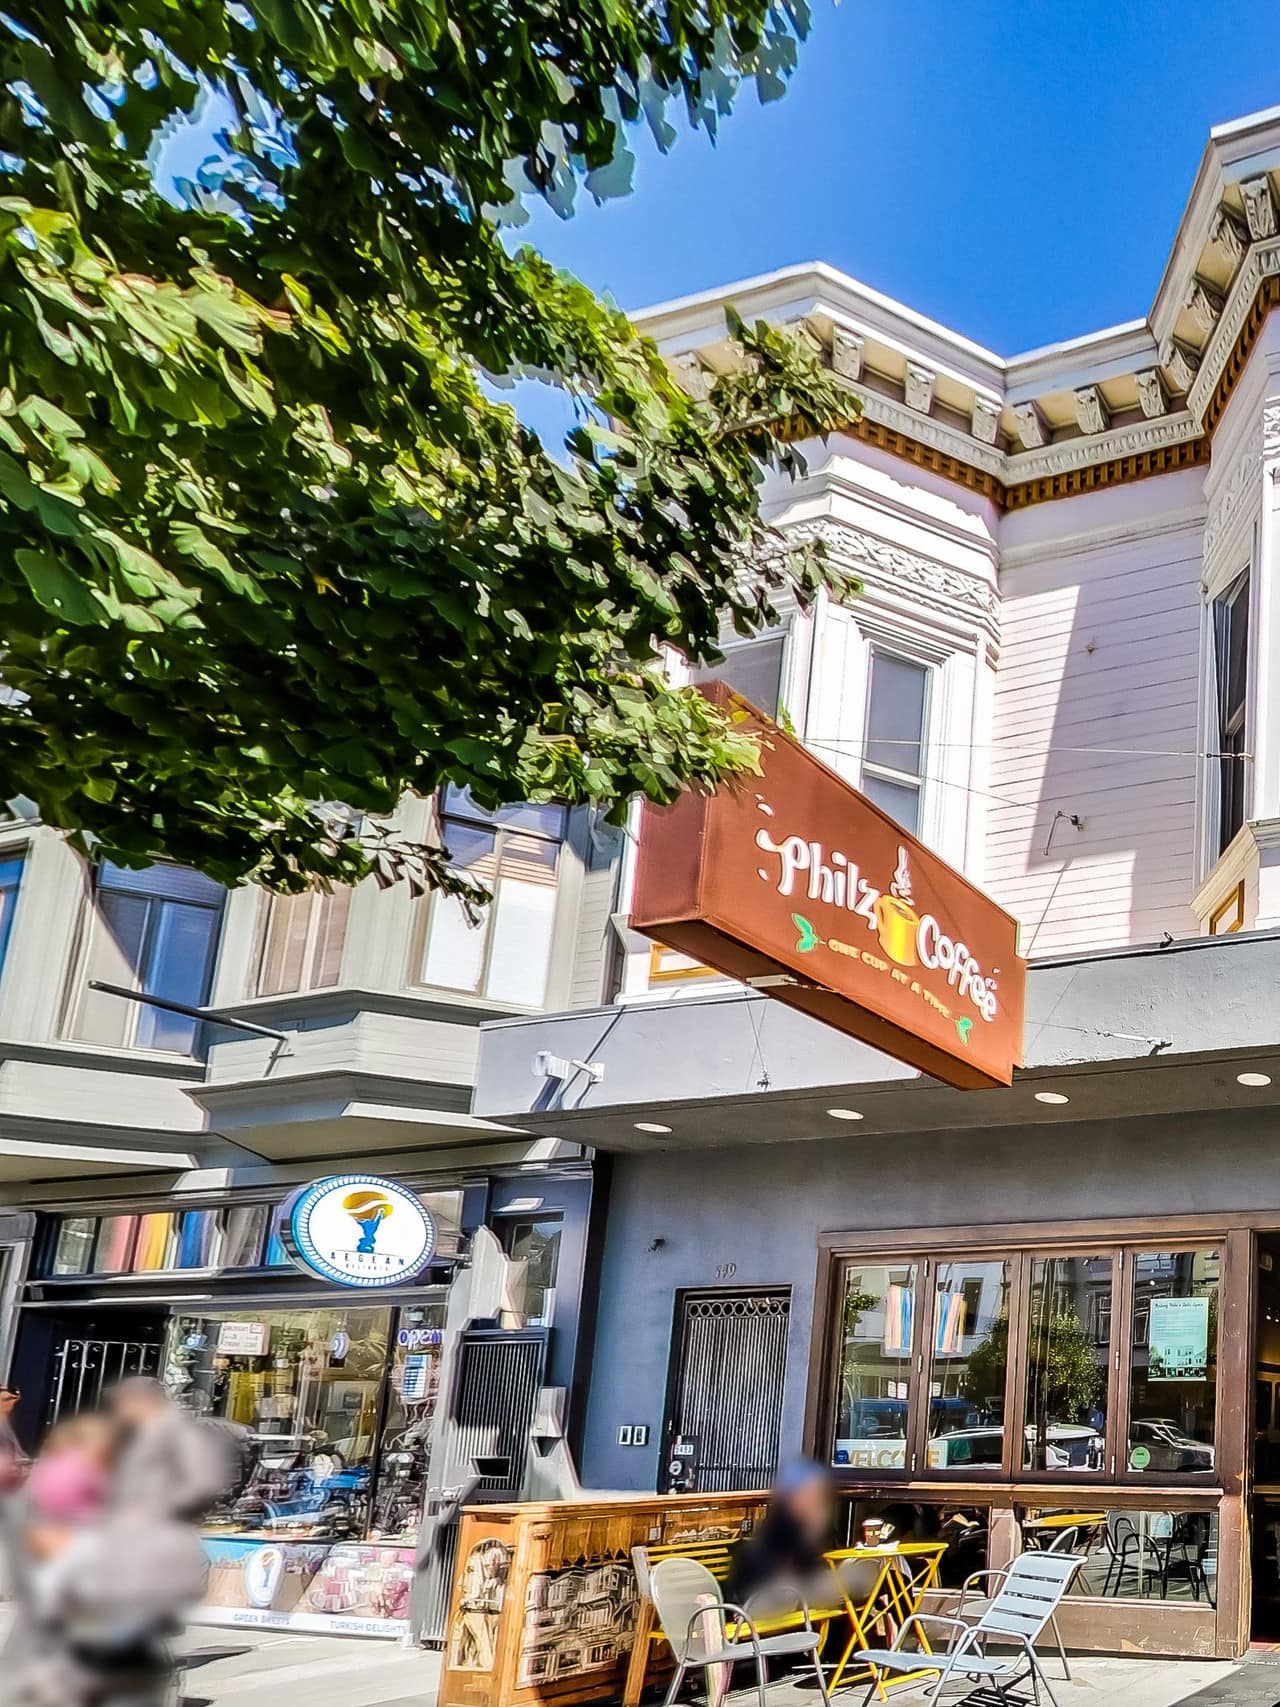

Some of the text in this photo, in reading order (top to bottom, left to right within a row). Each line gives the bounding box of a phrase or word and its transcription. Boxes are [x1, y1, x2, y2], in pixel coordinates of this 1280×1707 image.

[755, 828, 998, 1022] Philz Coffee
[860, 950, 890, 972] CUP
[910, 981, 922, 995] A
